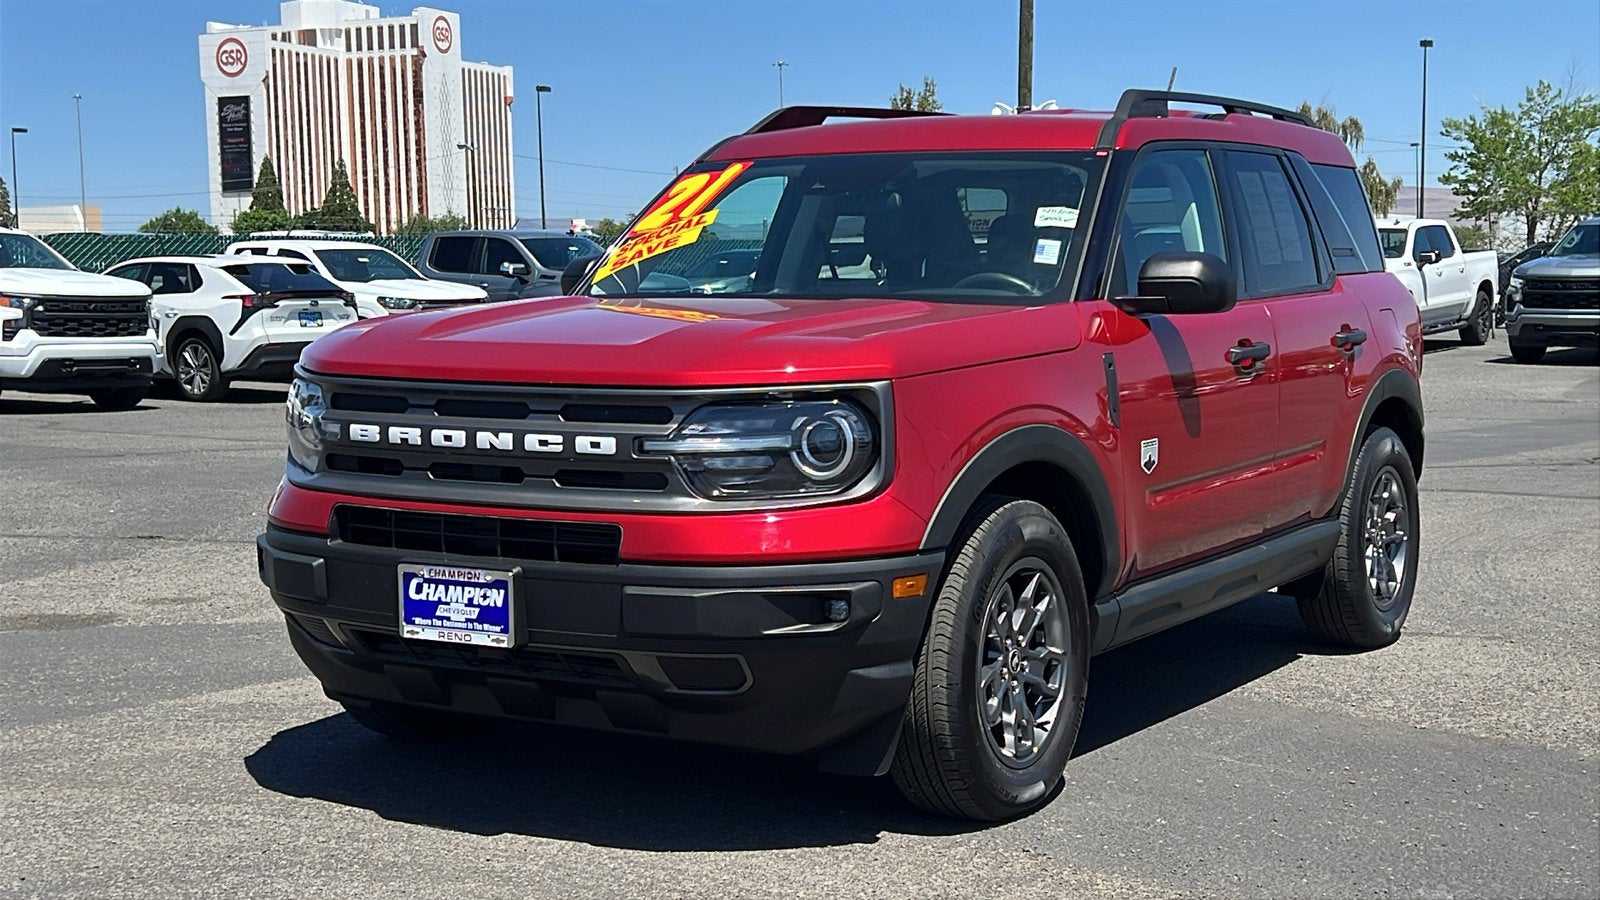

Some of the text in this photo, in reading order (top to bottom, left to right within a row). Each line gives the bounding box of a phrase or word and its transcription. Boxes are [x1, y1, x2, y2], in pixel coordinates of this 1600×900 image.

[435, 26, 451, 44] GSR
[219, 48, 244, 67] GSR
[633, 162, 745, 233] 21
[616, 214, 709, 258] SPECIAL
[610, 234, 682, 272] SAVE
[349, 423, 618, 456] BRONCO
[428, 567, 481, 581] CHAMPION
[408, 577, 505, 608] CHAMPION
[438, 606, 477, 616] CHEVROLET
[432, 618, 442, 626] The
[473, 621, 484, 630] The
[438, 631, 472, 642] RENO
